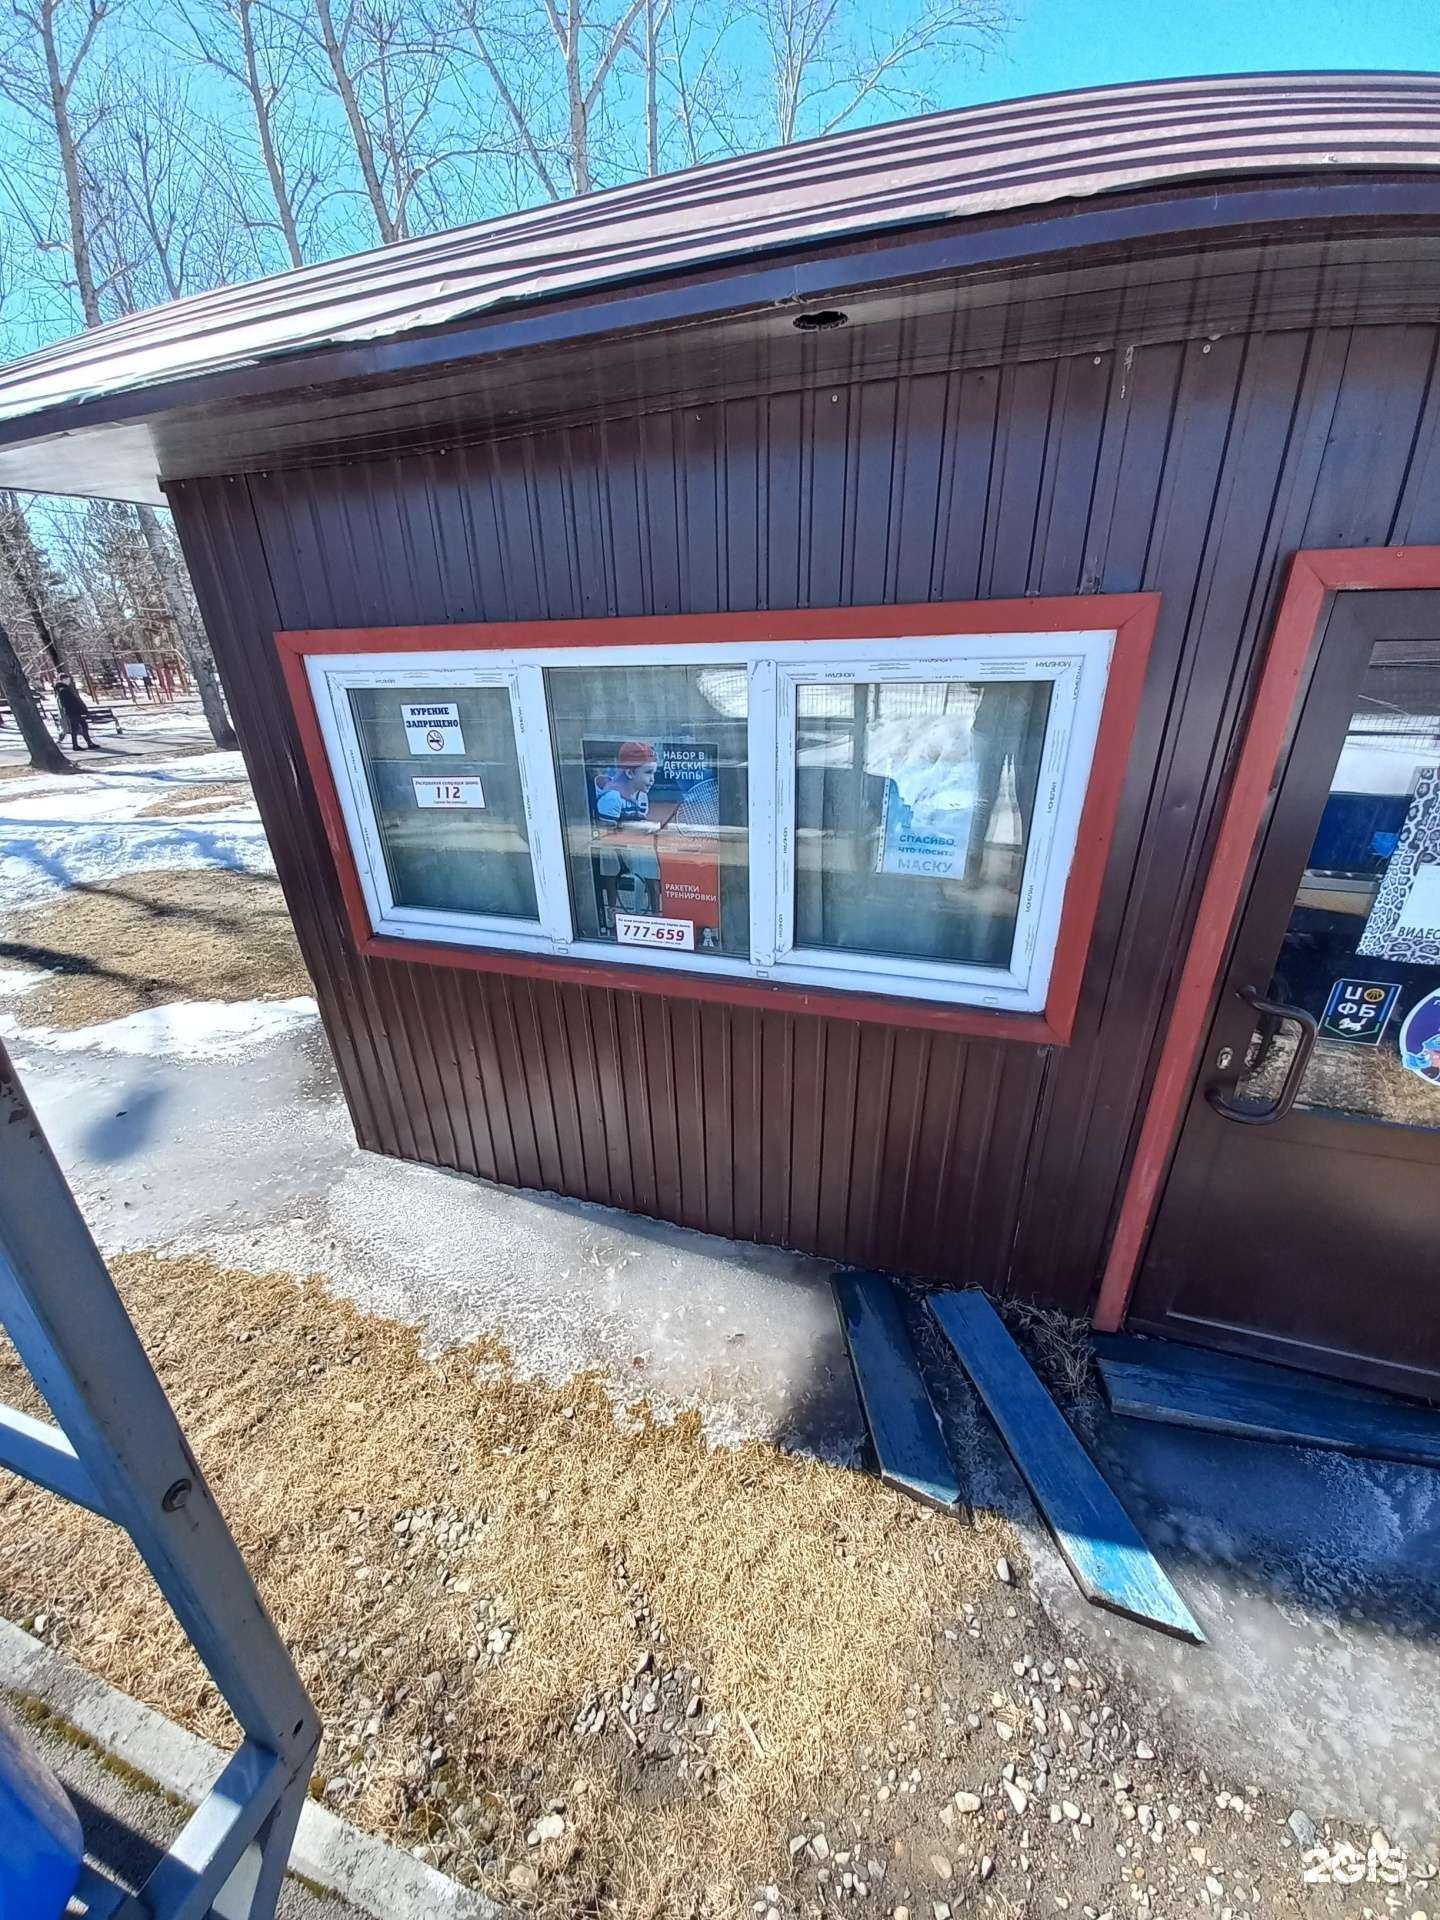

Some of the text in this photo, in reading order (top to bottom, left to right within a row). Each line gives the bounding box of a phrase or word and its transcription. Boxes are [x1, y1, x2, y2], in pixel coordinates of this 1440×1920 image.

[410, 707, 450, 716] КУРЕНИЕ
[406, 719, 459, 729] ЗАПРЕЩЕНО
[663, 751, 705, 760] НАБОР В
[663, 761, 705, 771] ДЕТСКИЕ
[664, 771, 704, 780] ГРУППЫ
[436, 786, 461, 799] 112
[897, 858, 953, 873] МАСКУ
[664, 883, 700, 893] РАКЕТКИ
[665, 891, 717, 902] ТРЕНИРОВКИ
[623, 925, 685, 942] 777-659
